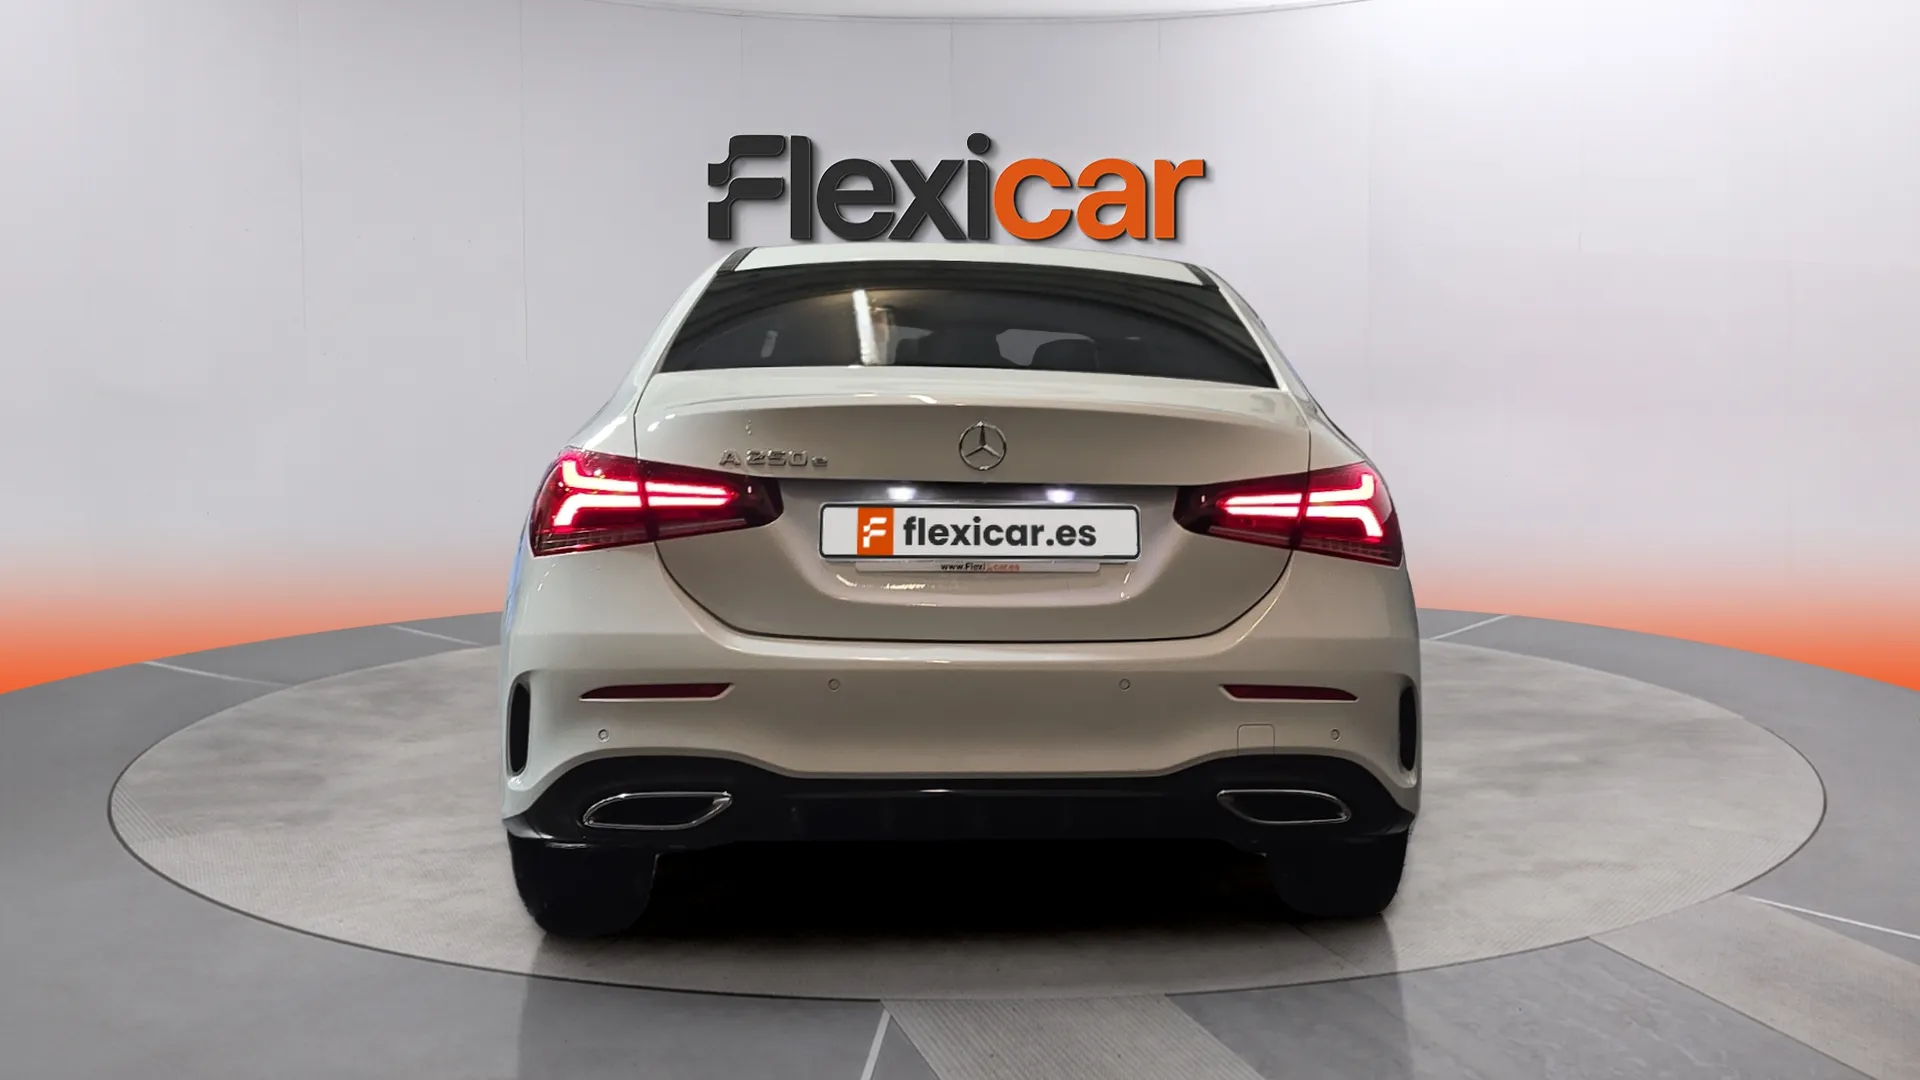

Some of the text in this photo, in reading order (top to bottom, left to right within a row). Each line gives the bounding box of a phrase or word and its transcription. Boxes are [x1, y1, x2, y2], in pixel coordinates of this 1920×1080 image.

[708, 133, 1204, 240] Flexicar
[719, 449, 741, 466] A
[903, 516, 1096, 547] flexicar.es
